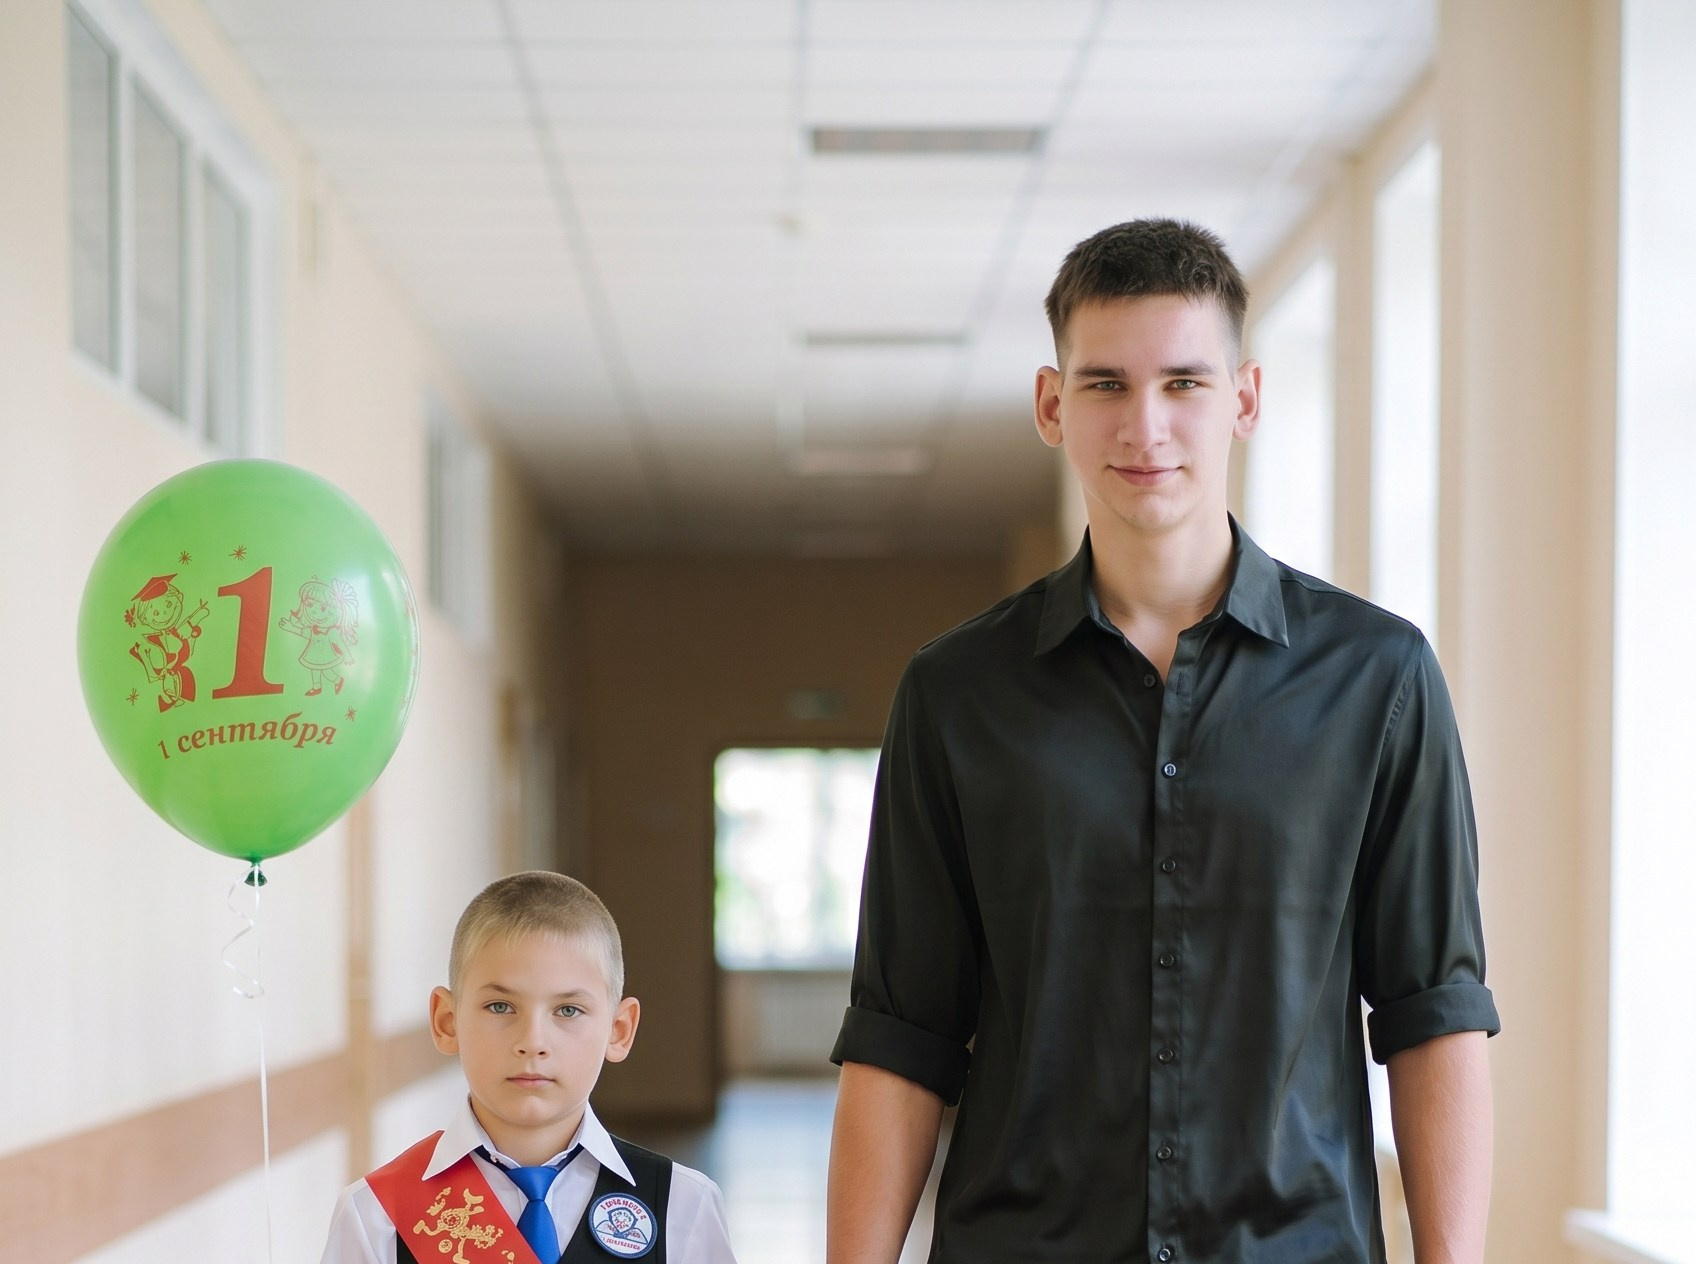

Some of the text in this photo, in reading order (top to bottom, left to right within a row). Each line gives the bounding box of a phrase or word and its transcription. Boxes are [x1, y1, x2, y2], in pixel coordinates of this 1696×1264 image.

[212, 566, 284, 699] 1
[157, 711, 337, 760] 1 сентября
